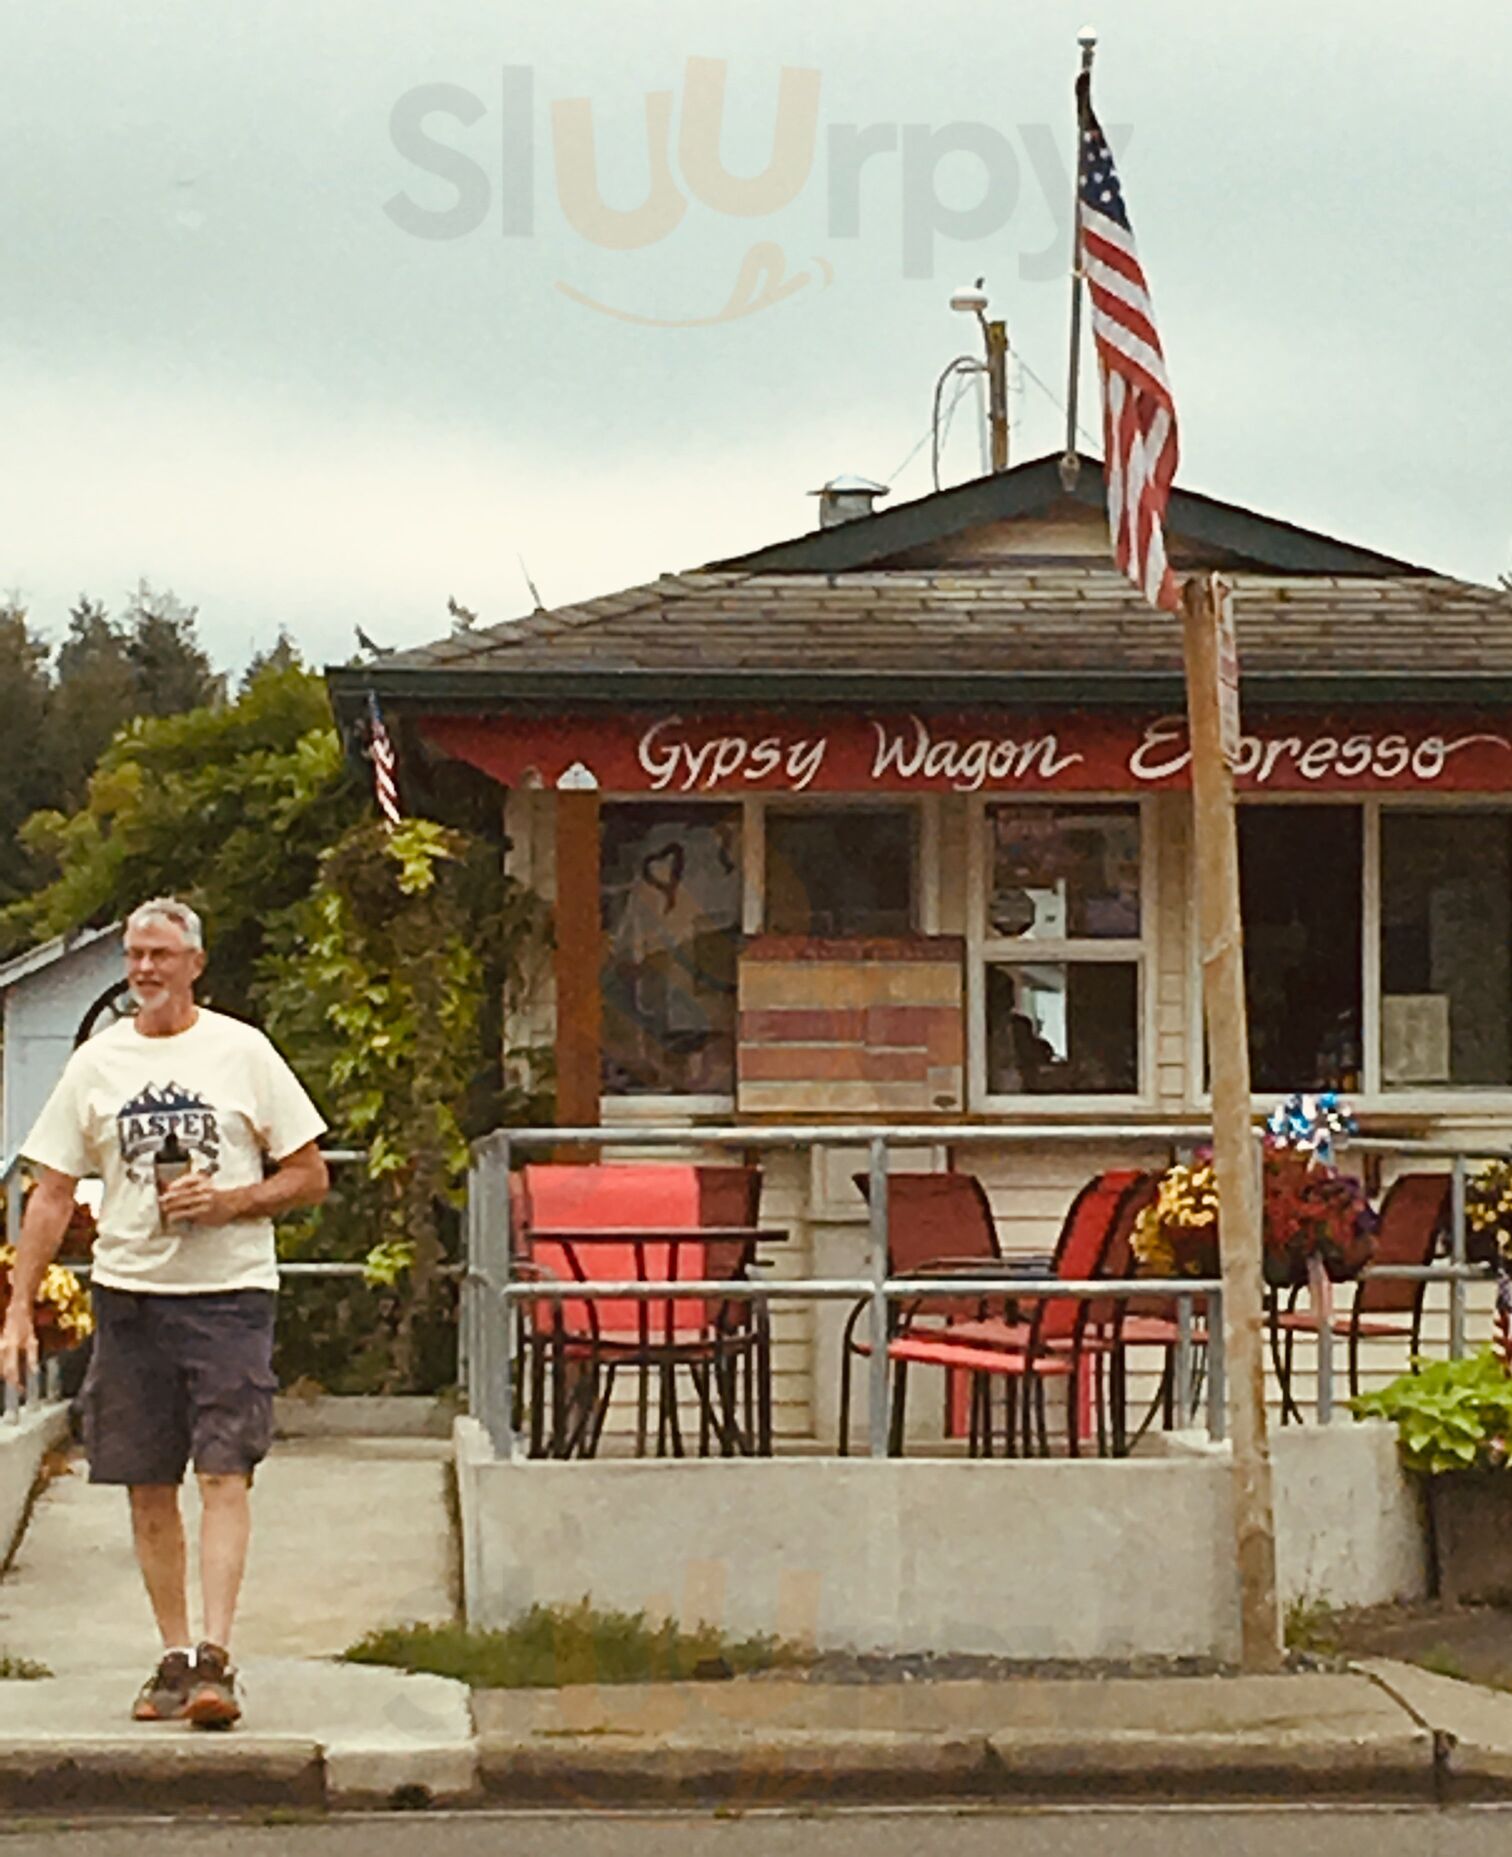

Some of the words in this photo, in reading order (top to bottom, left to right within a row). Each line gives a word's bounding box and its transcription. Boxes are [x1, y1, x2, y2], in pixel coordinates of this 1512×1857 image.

[638, 715, 827, 791] Gypsy
[870, 713, 1084, 792] Wagon
[1130, 714, 1511, 782] Epresso
